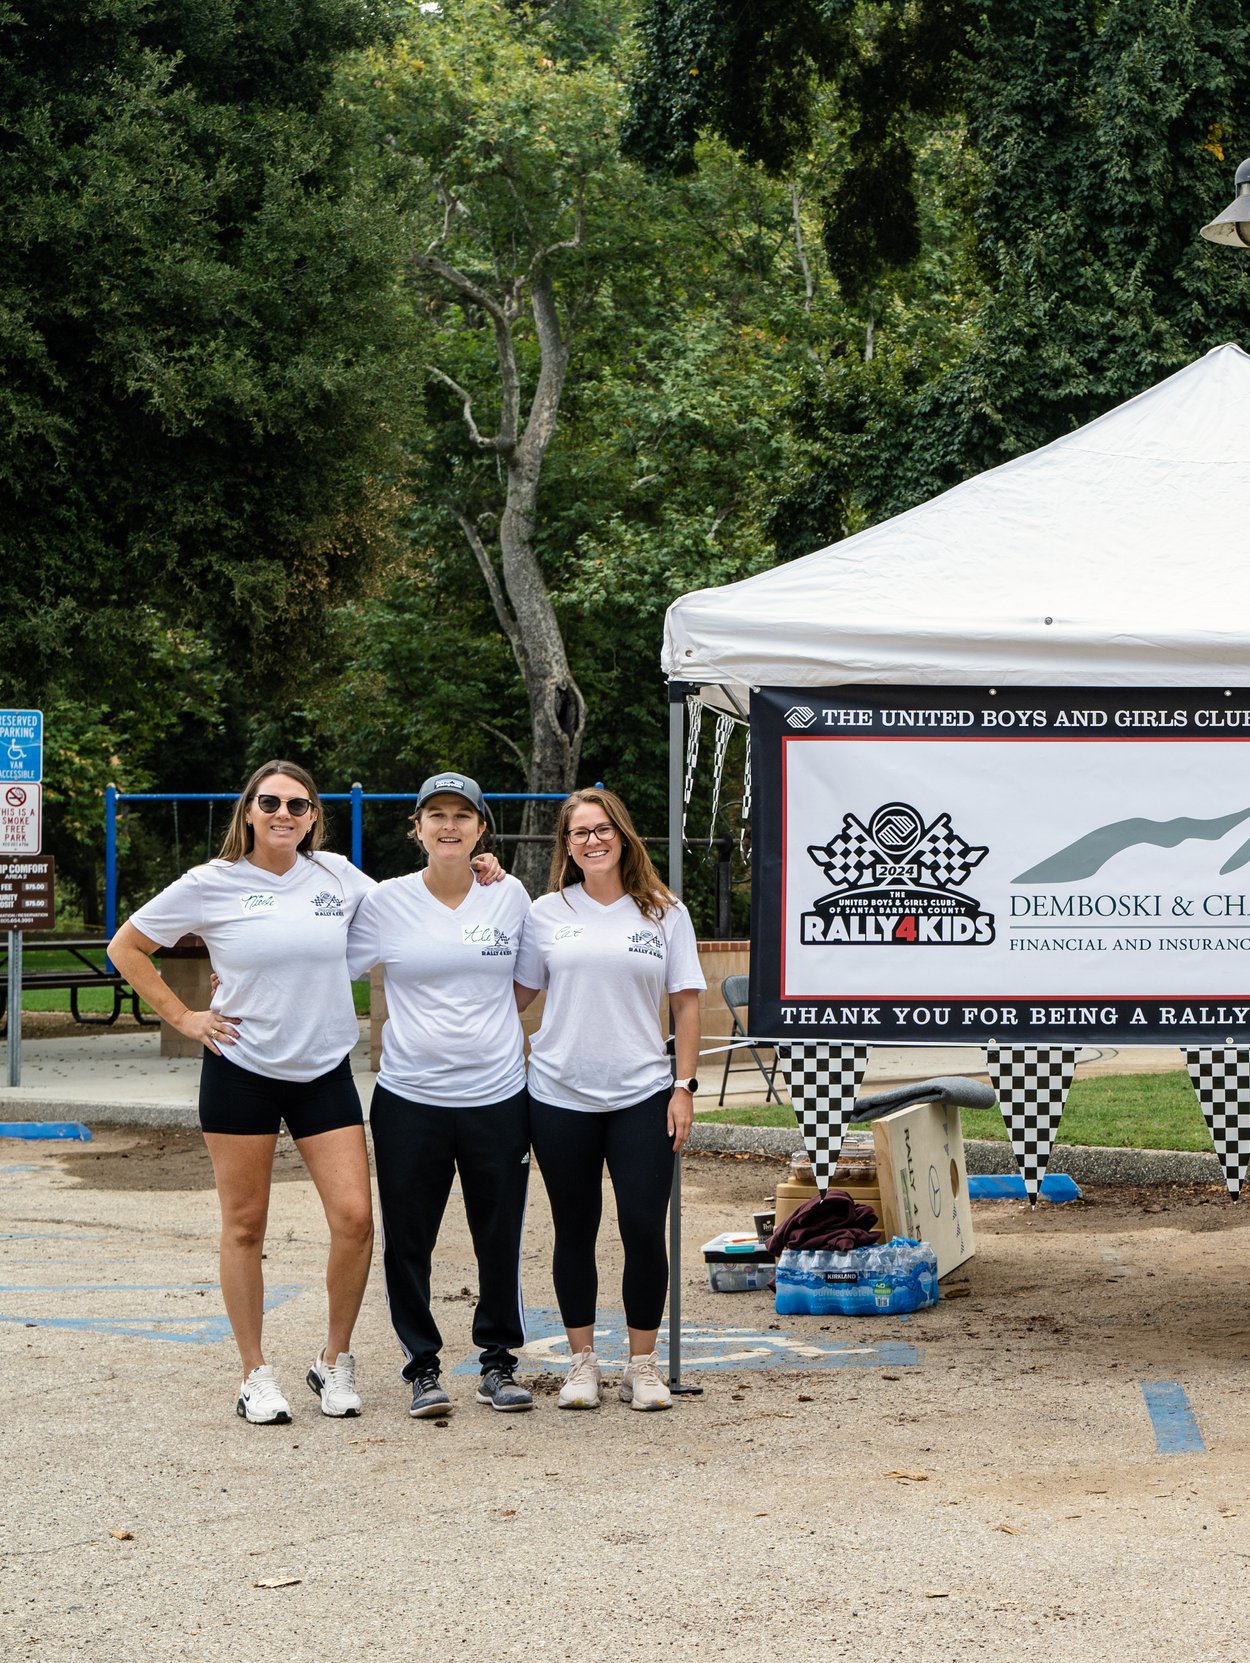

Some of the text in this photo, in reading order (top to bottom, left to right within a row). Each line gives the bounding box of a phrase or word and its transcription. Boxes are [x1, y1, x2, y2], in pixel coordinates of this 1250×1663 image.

[822, 709, 873, 727] THE
[881, 710, 975, 727] UNITED
[981, 710, 1047, 727] BOYS
[1053, 710, 1108, 727] AND
[1114, 710, 1188, 727] GIRLS
[0, 727, 34, 738] PARKING
[10, 761, 23, 769] VAN
[18, 808, 27, 816] IS
[30, 808, 35, 816] A
[2, 817, 30, 825] SMOKE
[5, 825, 26, 833] FREE
[5, 834, 26, 842] PARK
[9, 863, 49, 874] COMFORT
[879, 866, 915, 876] 2024
[1010, 894, 1161, 917] DEMBOSKI
[1172, 894, 1194, 917] &
[1010, 938, 1107, 951] FINANCIAL
[1113, 938, 1152, 951] AND
[782, 1007, 882, 1026] THANK
[892, 1007, 952, 1026] YOU
[962, 1007, 1019, 1026] FOR
[1029, 1007, 1119, 1026] BEING
[1130, 1007, 1147, 1026] A
[904, 1128, 917, 1192] RALLY
